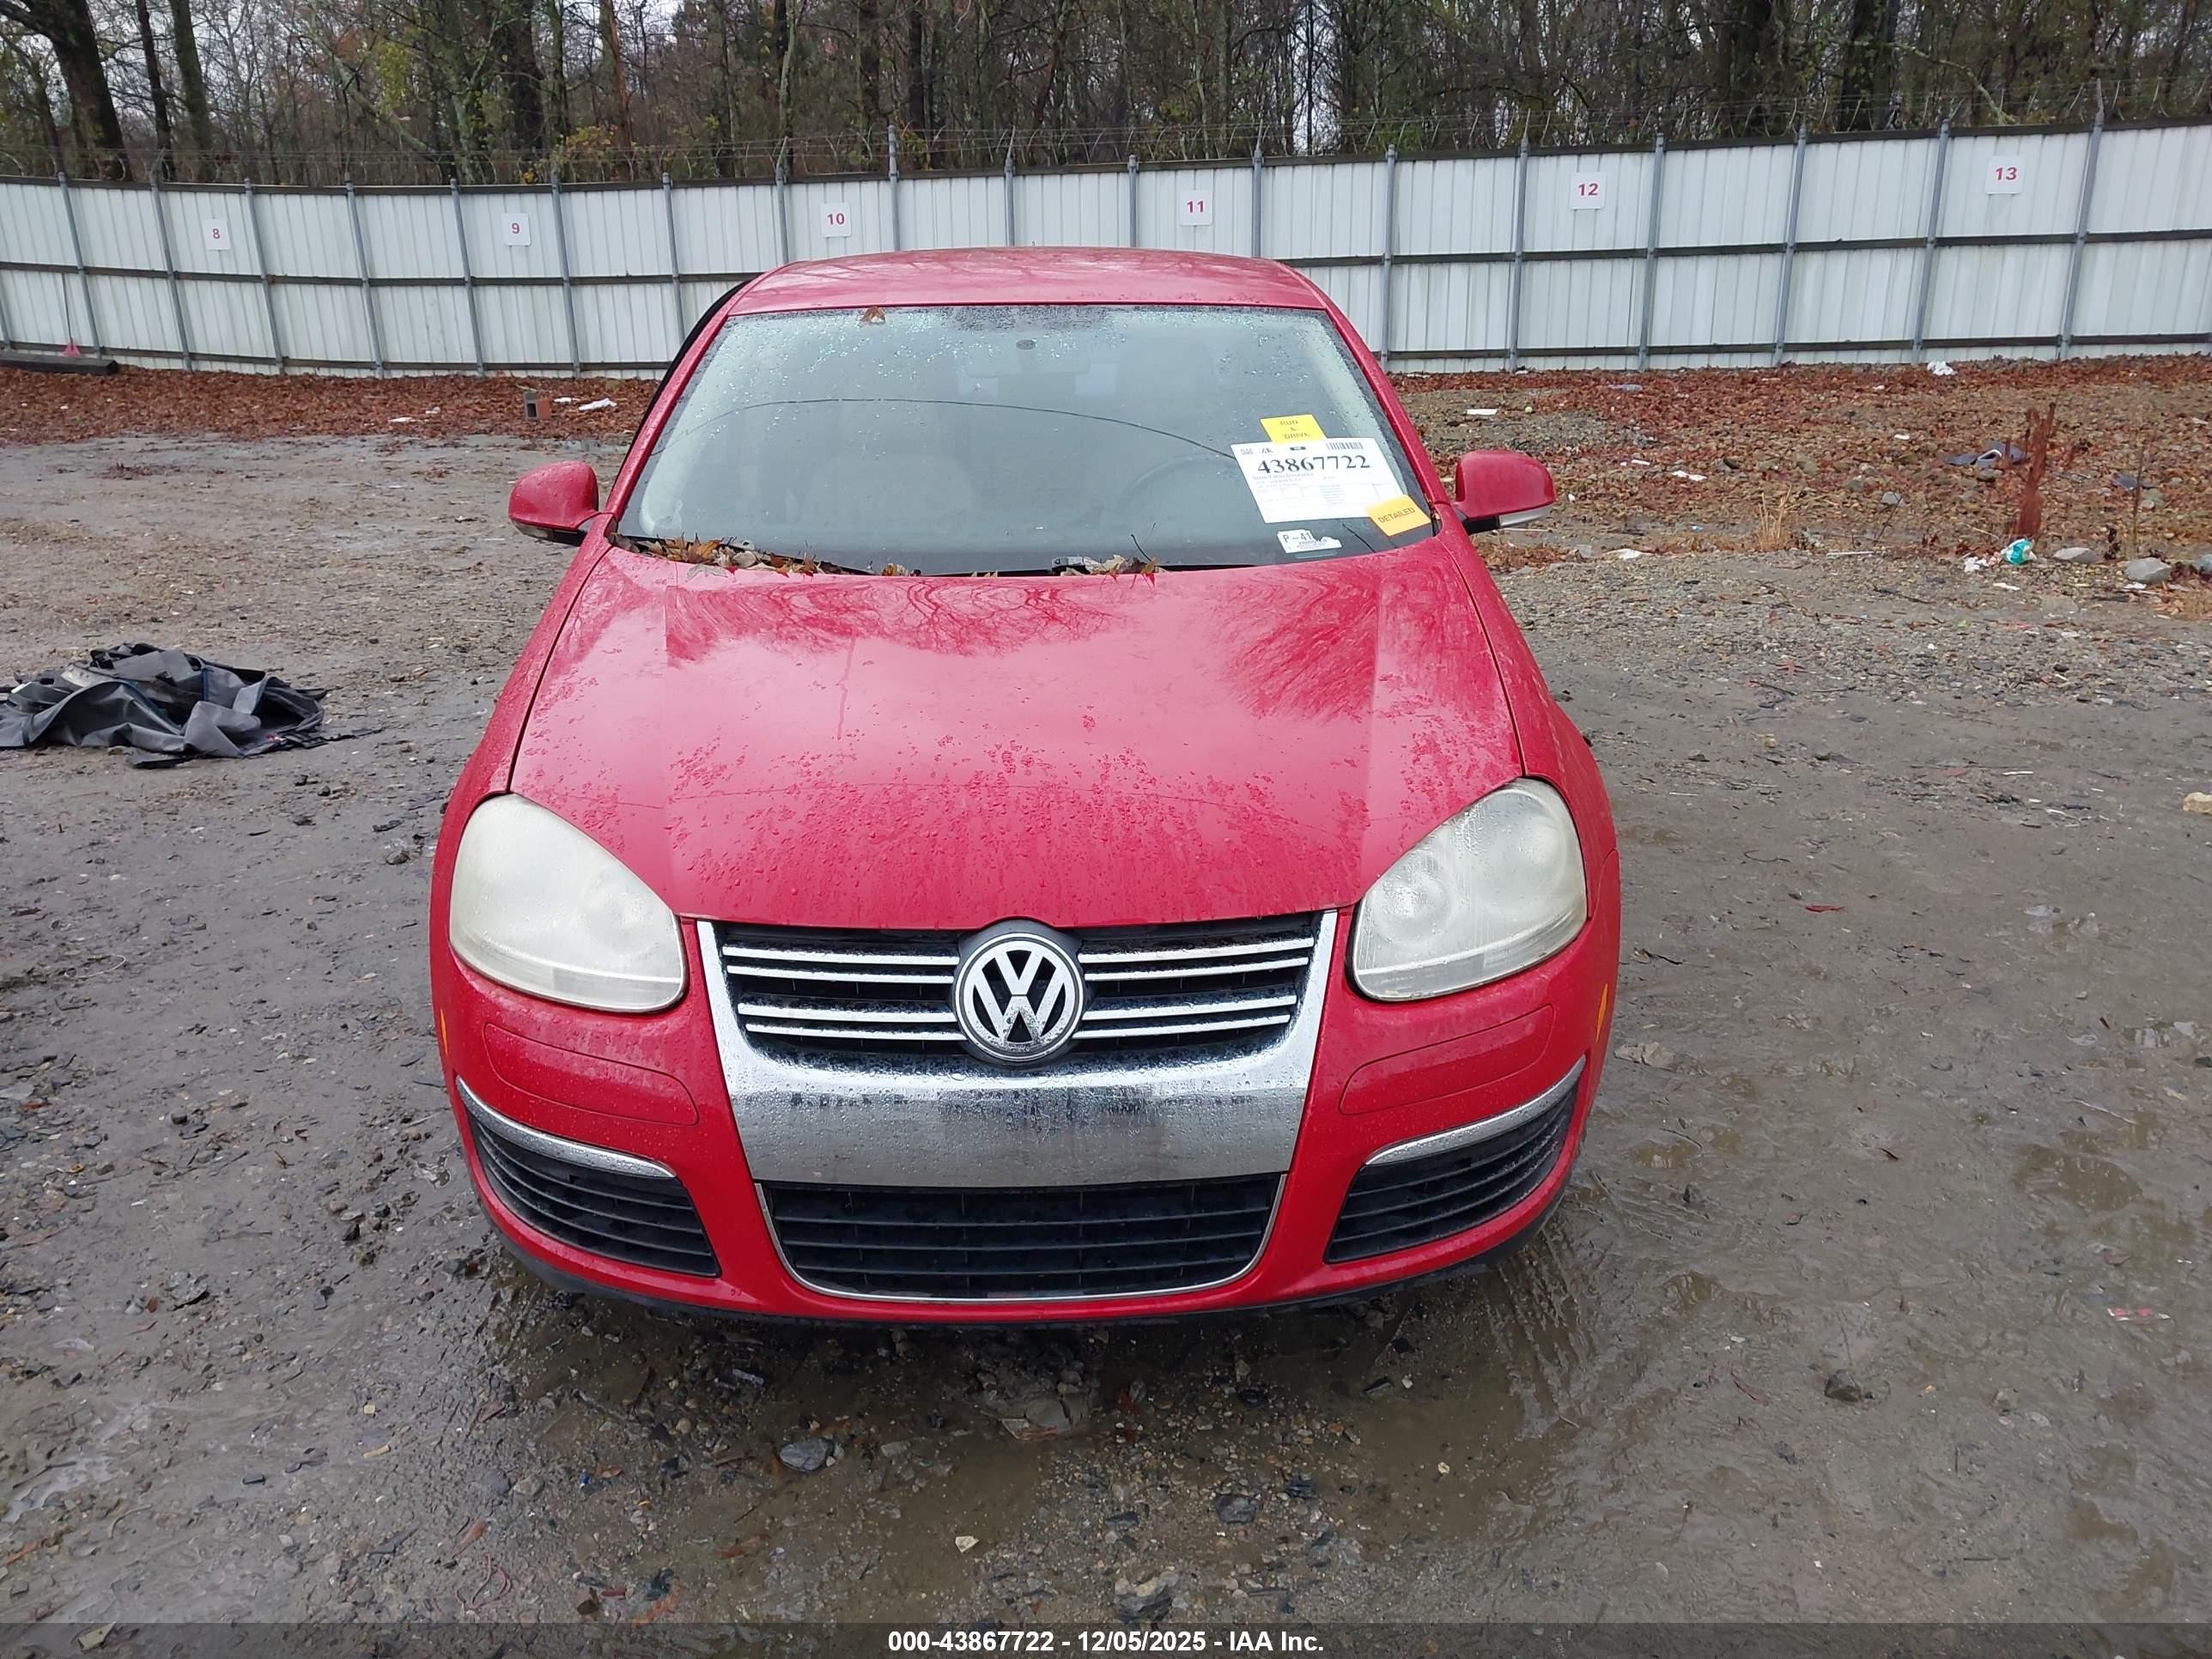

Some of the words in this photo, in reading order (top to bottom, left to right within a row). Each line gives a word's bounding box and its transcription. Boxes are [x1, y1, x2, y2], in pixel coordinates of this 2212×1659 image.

[1995, 167, 2018, 181] 13
[1578, 181, 1599, 196] 12
[1187, 200, 1205, 213] 11
[827, 213, 845, 225] 10
[212, 228, 221, 239] 8
[511, 222, 520, 234] 9
[1257, 455, 1370, 474] 43867722
[1377, 507, 1416, 523] DETAILED
